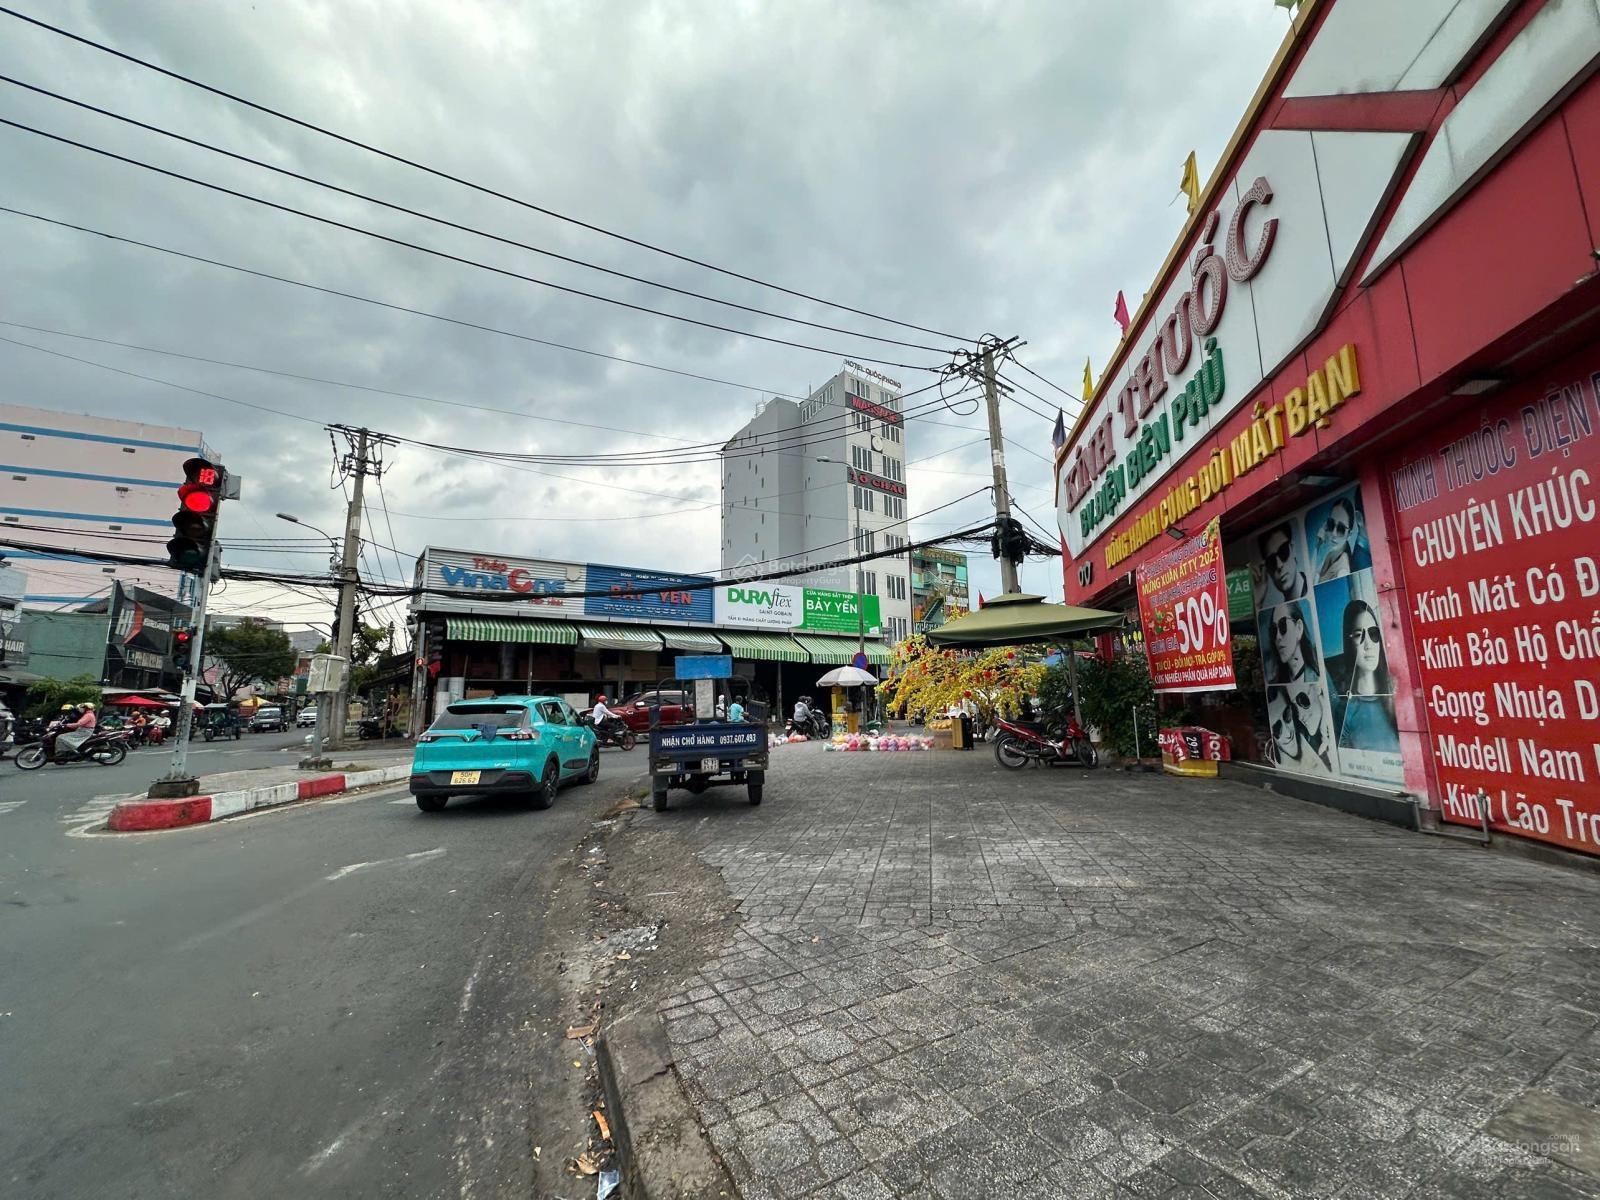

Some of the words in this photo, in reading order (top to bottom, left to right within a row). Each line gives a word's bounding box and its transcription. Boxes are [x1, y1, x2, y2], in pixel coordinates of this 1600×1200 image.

[1064, 412, 1117, 514] KÍNH
[1117, 176, 1279, 439] THUỐC
[1125, 413, 1171, 490] BIÊN
[1170, 336, 1226, 442] PHỦ
[1520, 378, 1592, 459] ĐIỆN
[1159, 476, 1201, 530] CÙNG
[1197, 446, 1233, 503] ĐÔI
[1284, 343, 1361, 439] BẠN
[1412, 497, 1504, 567] CHUYÊN
[1508, 466, 1596, 540] KHÚC
[1198, 545, 1219, 568] 2025
[806, 597, 831, 612] BẢY
[1467, 575, 1520, 615] Mát
[1525, 562, 1566, 605] Có
[1175, 588, 1228, 654] 50%
[4, 639, 25, 653] HAIR
[1466, 627, 1509, 667] Bảo
[1513, 624, 1549, 670] Hộ
[1493, 681, 1566, 727] Nhựa
[661, 736, 680, 748] NHẬN
[681, 733, 696, 746] CHỞ
[696, 734, 715, 745] HÀNG
[1517, 738, 1586, 783] Nam
[1500, 789, 1550, 834] Lão
